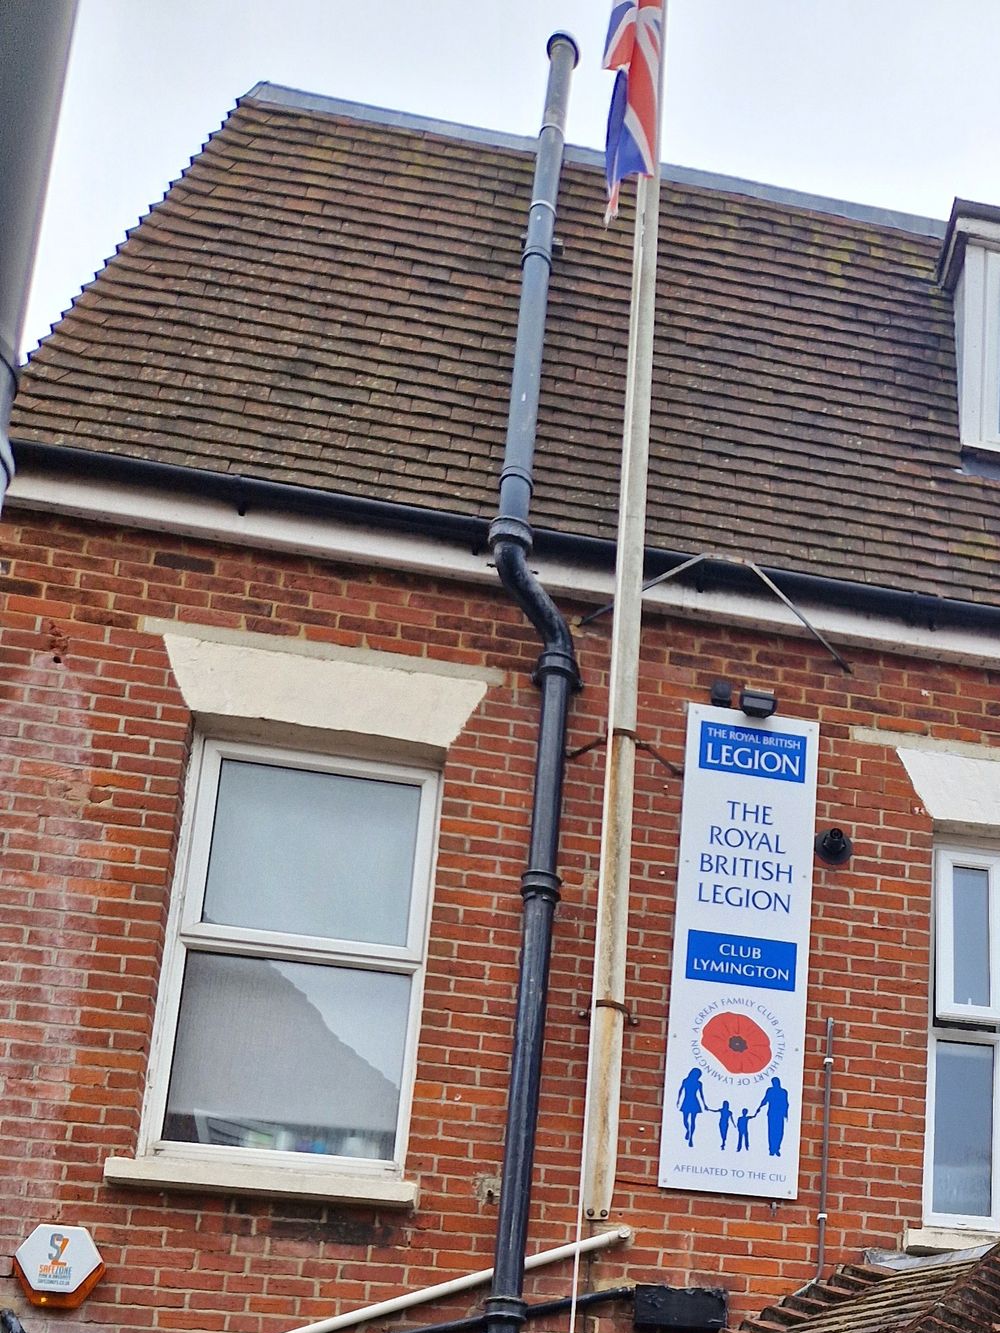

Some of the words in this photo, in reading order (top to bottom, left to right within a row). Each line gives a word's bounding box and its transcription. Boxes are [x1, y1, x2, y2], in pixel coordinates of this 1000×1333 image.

[708, 727, 727, 739] THE
[729, 731, 761, 744] ROYAL
[762, 736, 801, 750] BRITISH
[706, 742, 800, 776] LEGION
[727, 800, 773, 826] THE
[709, 825, 786, 854] ROYAL
[699, 853, 793, 884] BRITISH
[697, 882, 791, 914] LEGION
[719, 943, 762, 959] CLUB
[693, 958, 790, 981] LYMINGTON
[694, 1000, 719, 1026] GREAT
[720, 997, 756, 1008] FAMILY
[756, 1004, 780, 1027] CLUB
[775, 1025, 785, 1040] AT
[691, 1040, 734, 1085] LYMINGTON
[776, 1040, 786, 1062] THE
[737, 1077, 751, 1086] OF
[753, 1060, 779, 1084] HEART
[673, 1163, 728, 1178] AFFILIATED
[730, 1169, 744, 1179] TO
[746, 1170, 768, 1181] THE
[769, 1172, 787, 1183] CIU
